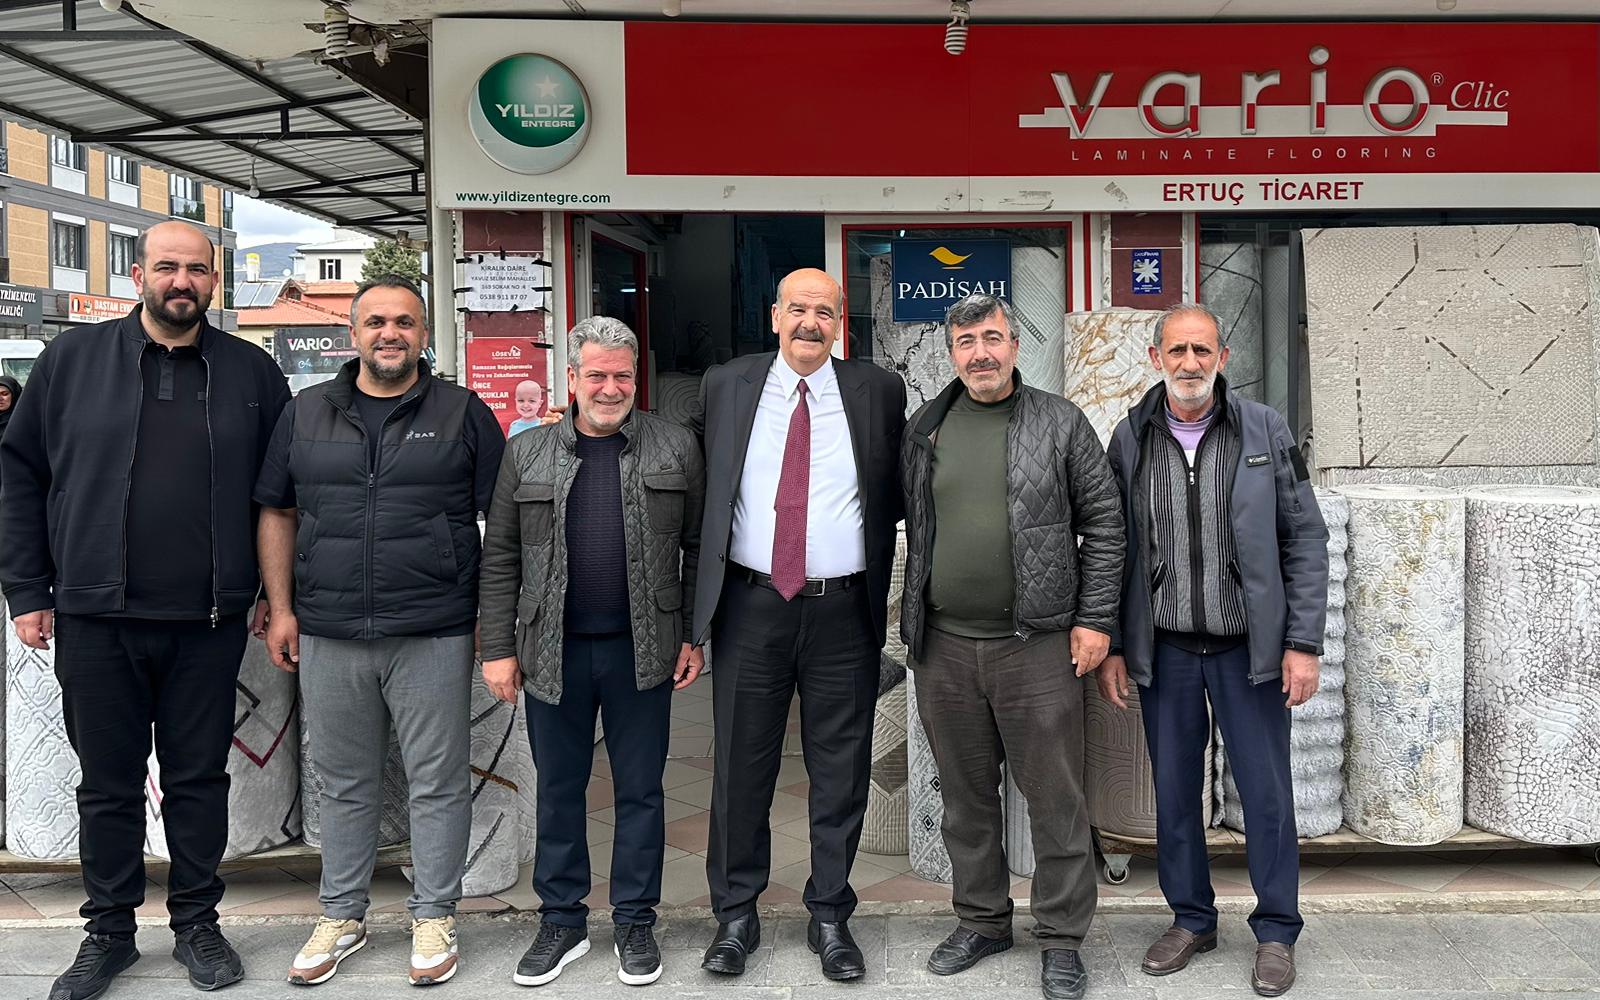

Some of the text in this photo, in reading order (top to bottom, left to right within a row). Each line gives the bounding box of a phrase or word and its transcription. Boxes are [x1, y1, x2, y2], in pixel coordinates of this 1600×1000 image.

[1050, 45, 1431, 139] vario
[1450, 80, 1510, 109] Clic
[495, 103, 575, 118] YILDIZ
[521, 120, 576, 128] ENTEGRE
[1071, 147, 1436, 161] LAMINATE FLOORING
[456, 191, 611, 205] www.yildizentegre.com
[1163, 178, 1364, 206] ERTUÇ TİCARET
[0, 289, 37, 303] YRİMENKUL
[473, 381, 491, 389] ÖNCE
